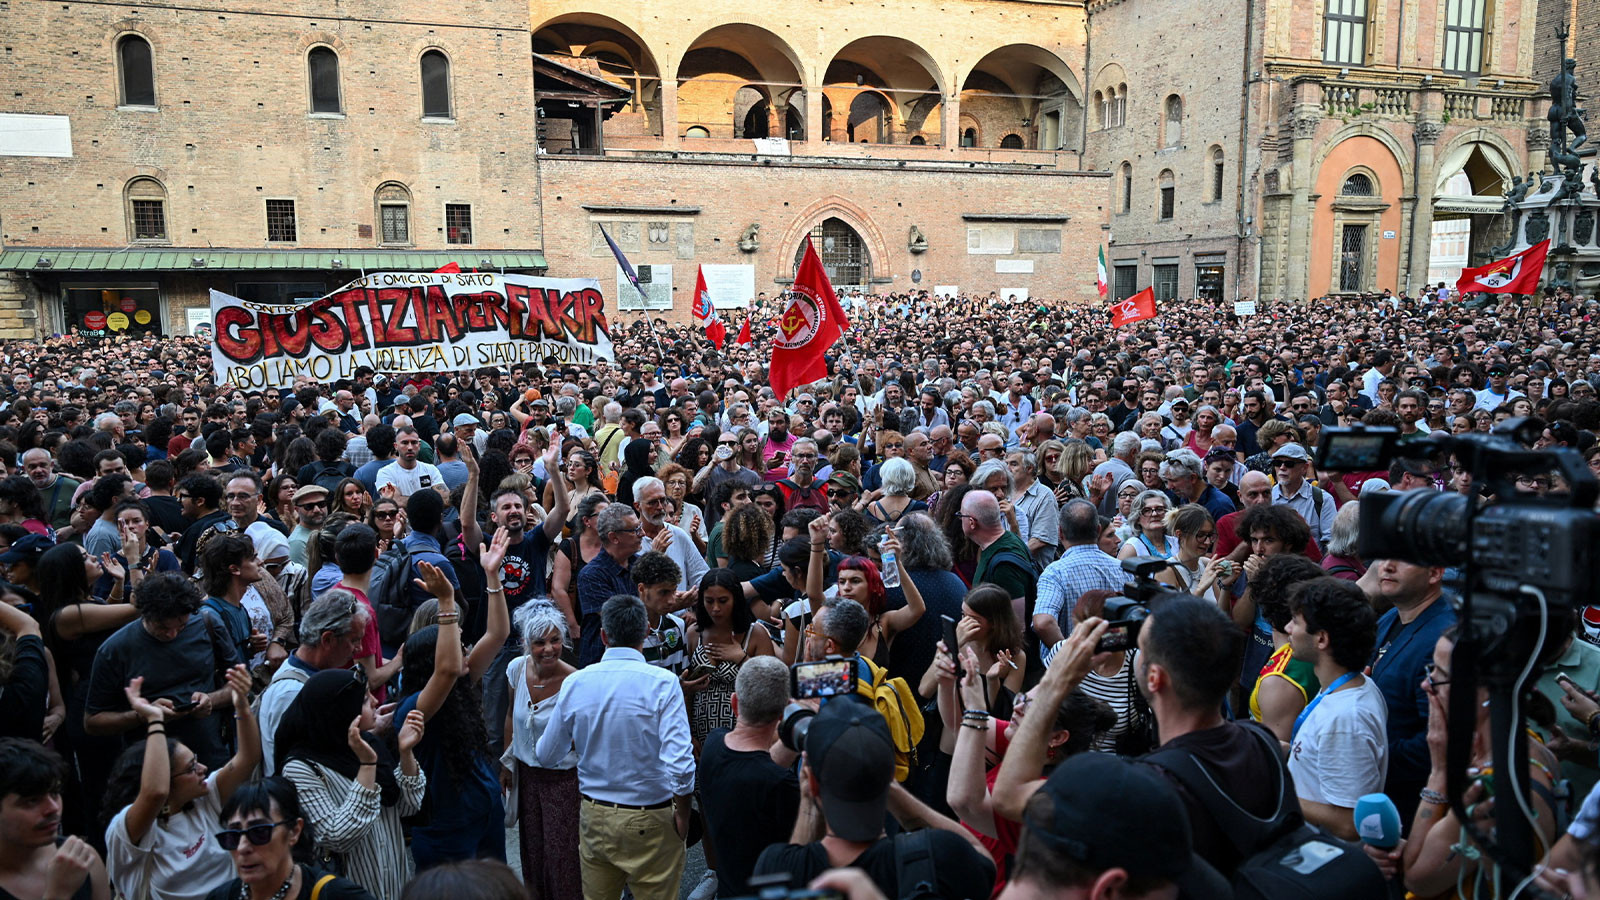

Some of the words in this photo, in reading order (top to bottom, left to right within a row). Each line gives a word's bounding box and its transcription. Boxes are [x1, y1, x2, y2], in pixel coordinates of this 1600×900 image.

[242, 302, 306, 313] CONTRO
[383, 273, 434, 286] OMICIDI
[441, 274, 453, 284] DI
[455, 273, 494, 287] STATO
[215, 284, 466, 366] GIUSTIZIA
[452, 290, 509, 333] PER
[504, 282, 611, 345] FAKIR
[227, 355, 333, 390] ABOLIAMO
[339, 352, 359, 378] LA
[366, 345, 448, 373] VIOLENZA
[452, 346, 471, 367] DI
[478, 342, 517, 365] STATO
